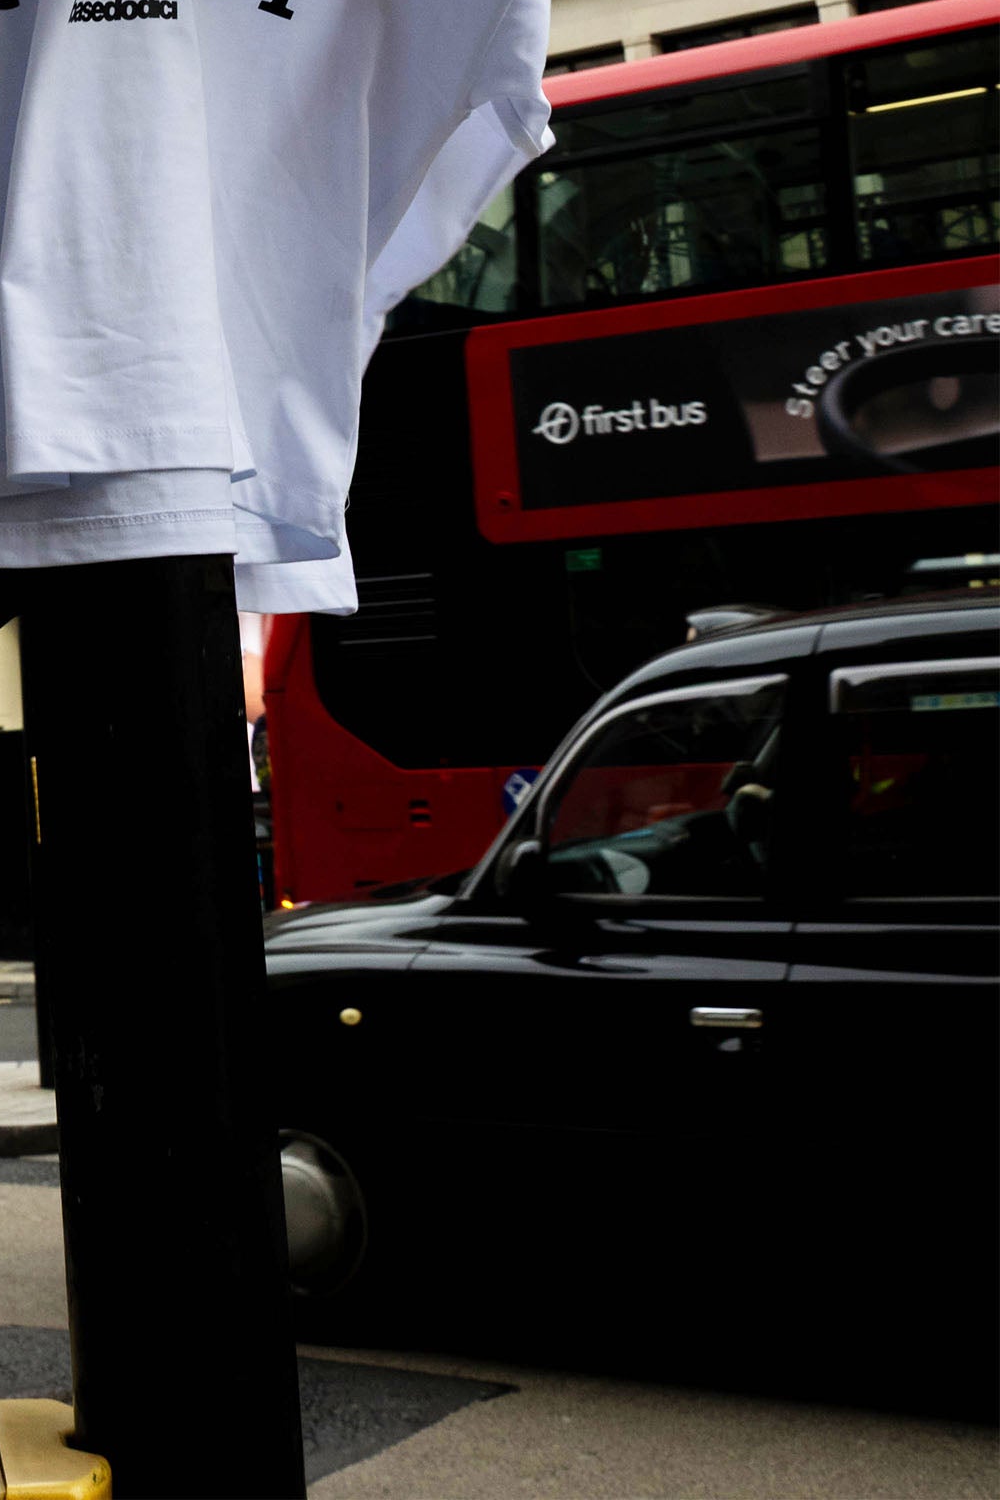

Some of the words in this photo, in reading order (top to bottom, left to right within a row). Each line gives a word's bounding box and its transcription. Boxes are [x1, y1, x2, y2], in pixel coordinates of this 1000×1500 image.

[785, 341, 850, 418] Steer
[856, 319, 929, 357] your
[934, 314, 1000, 337] care
[581, 401, 647, 435] first
[649, 398, 707, 429] bus
